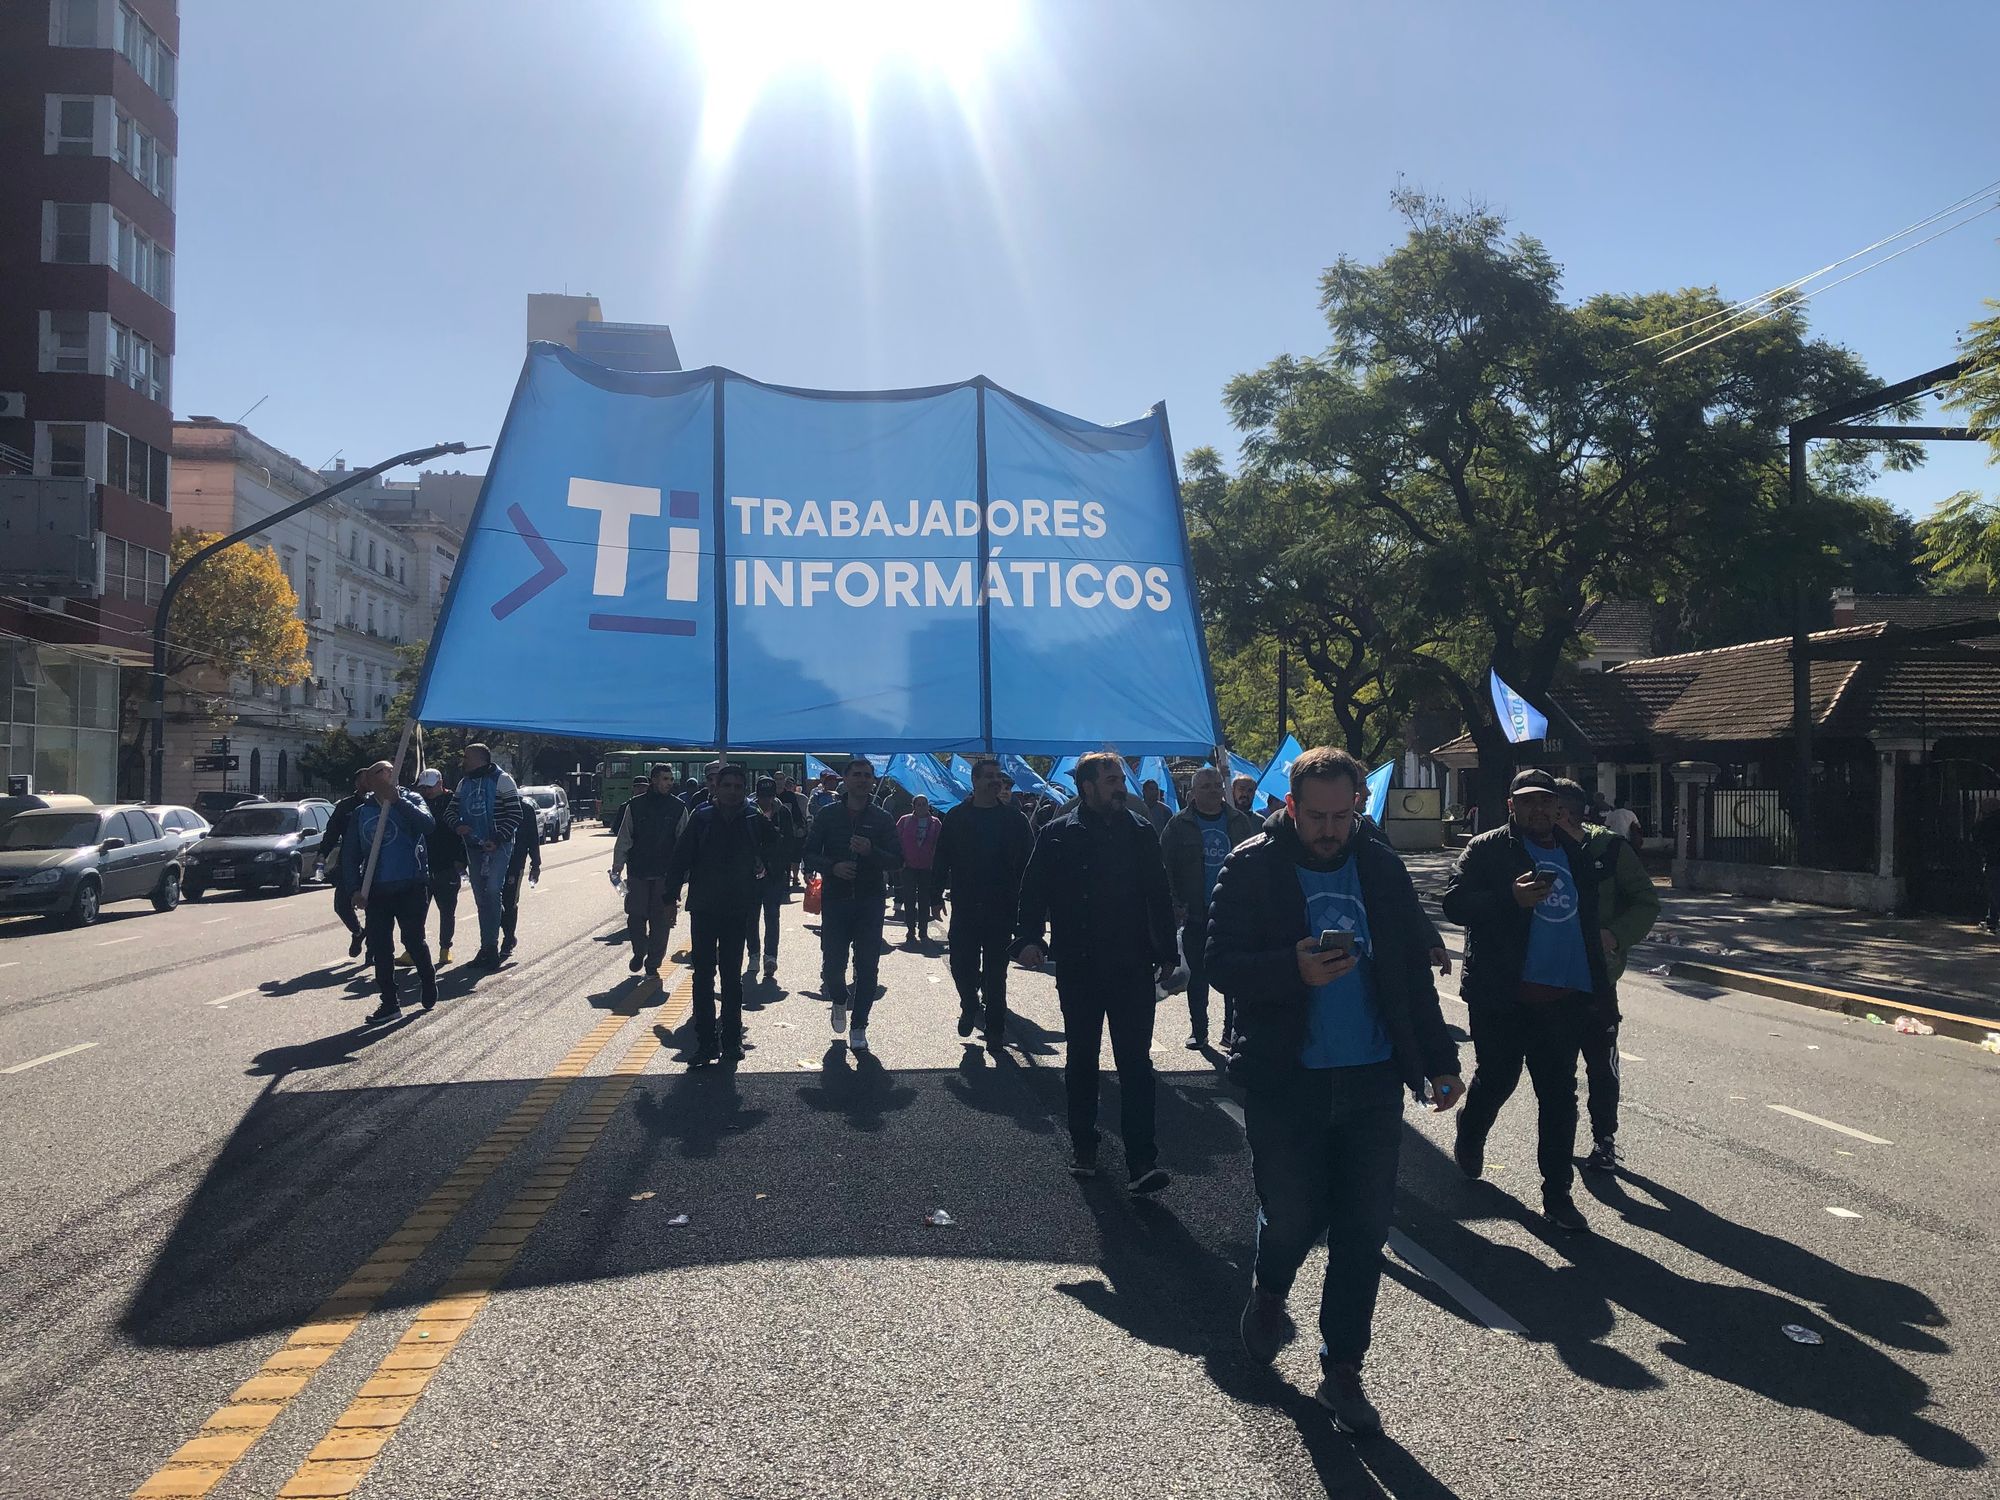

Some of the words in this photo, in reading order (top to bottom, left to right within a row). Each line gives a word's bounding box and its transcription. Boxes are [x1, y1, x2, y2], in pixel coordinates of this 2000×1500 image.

[567, 477, 699, 602] Ti
[731, 496, 1107, 539] TRABAJADORES
[735, 547, 1171, 612] INFORMÁTICOS
[1543, 892, 1571, 909] GC
